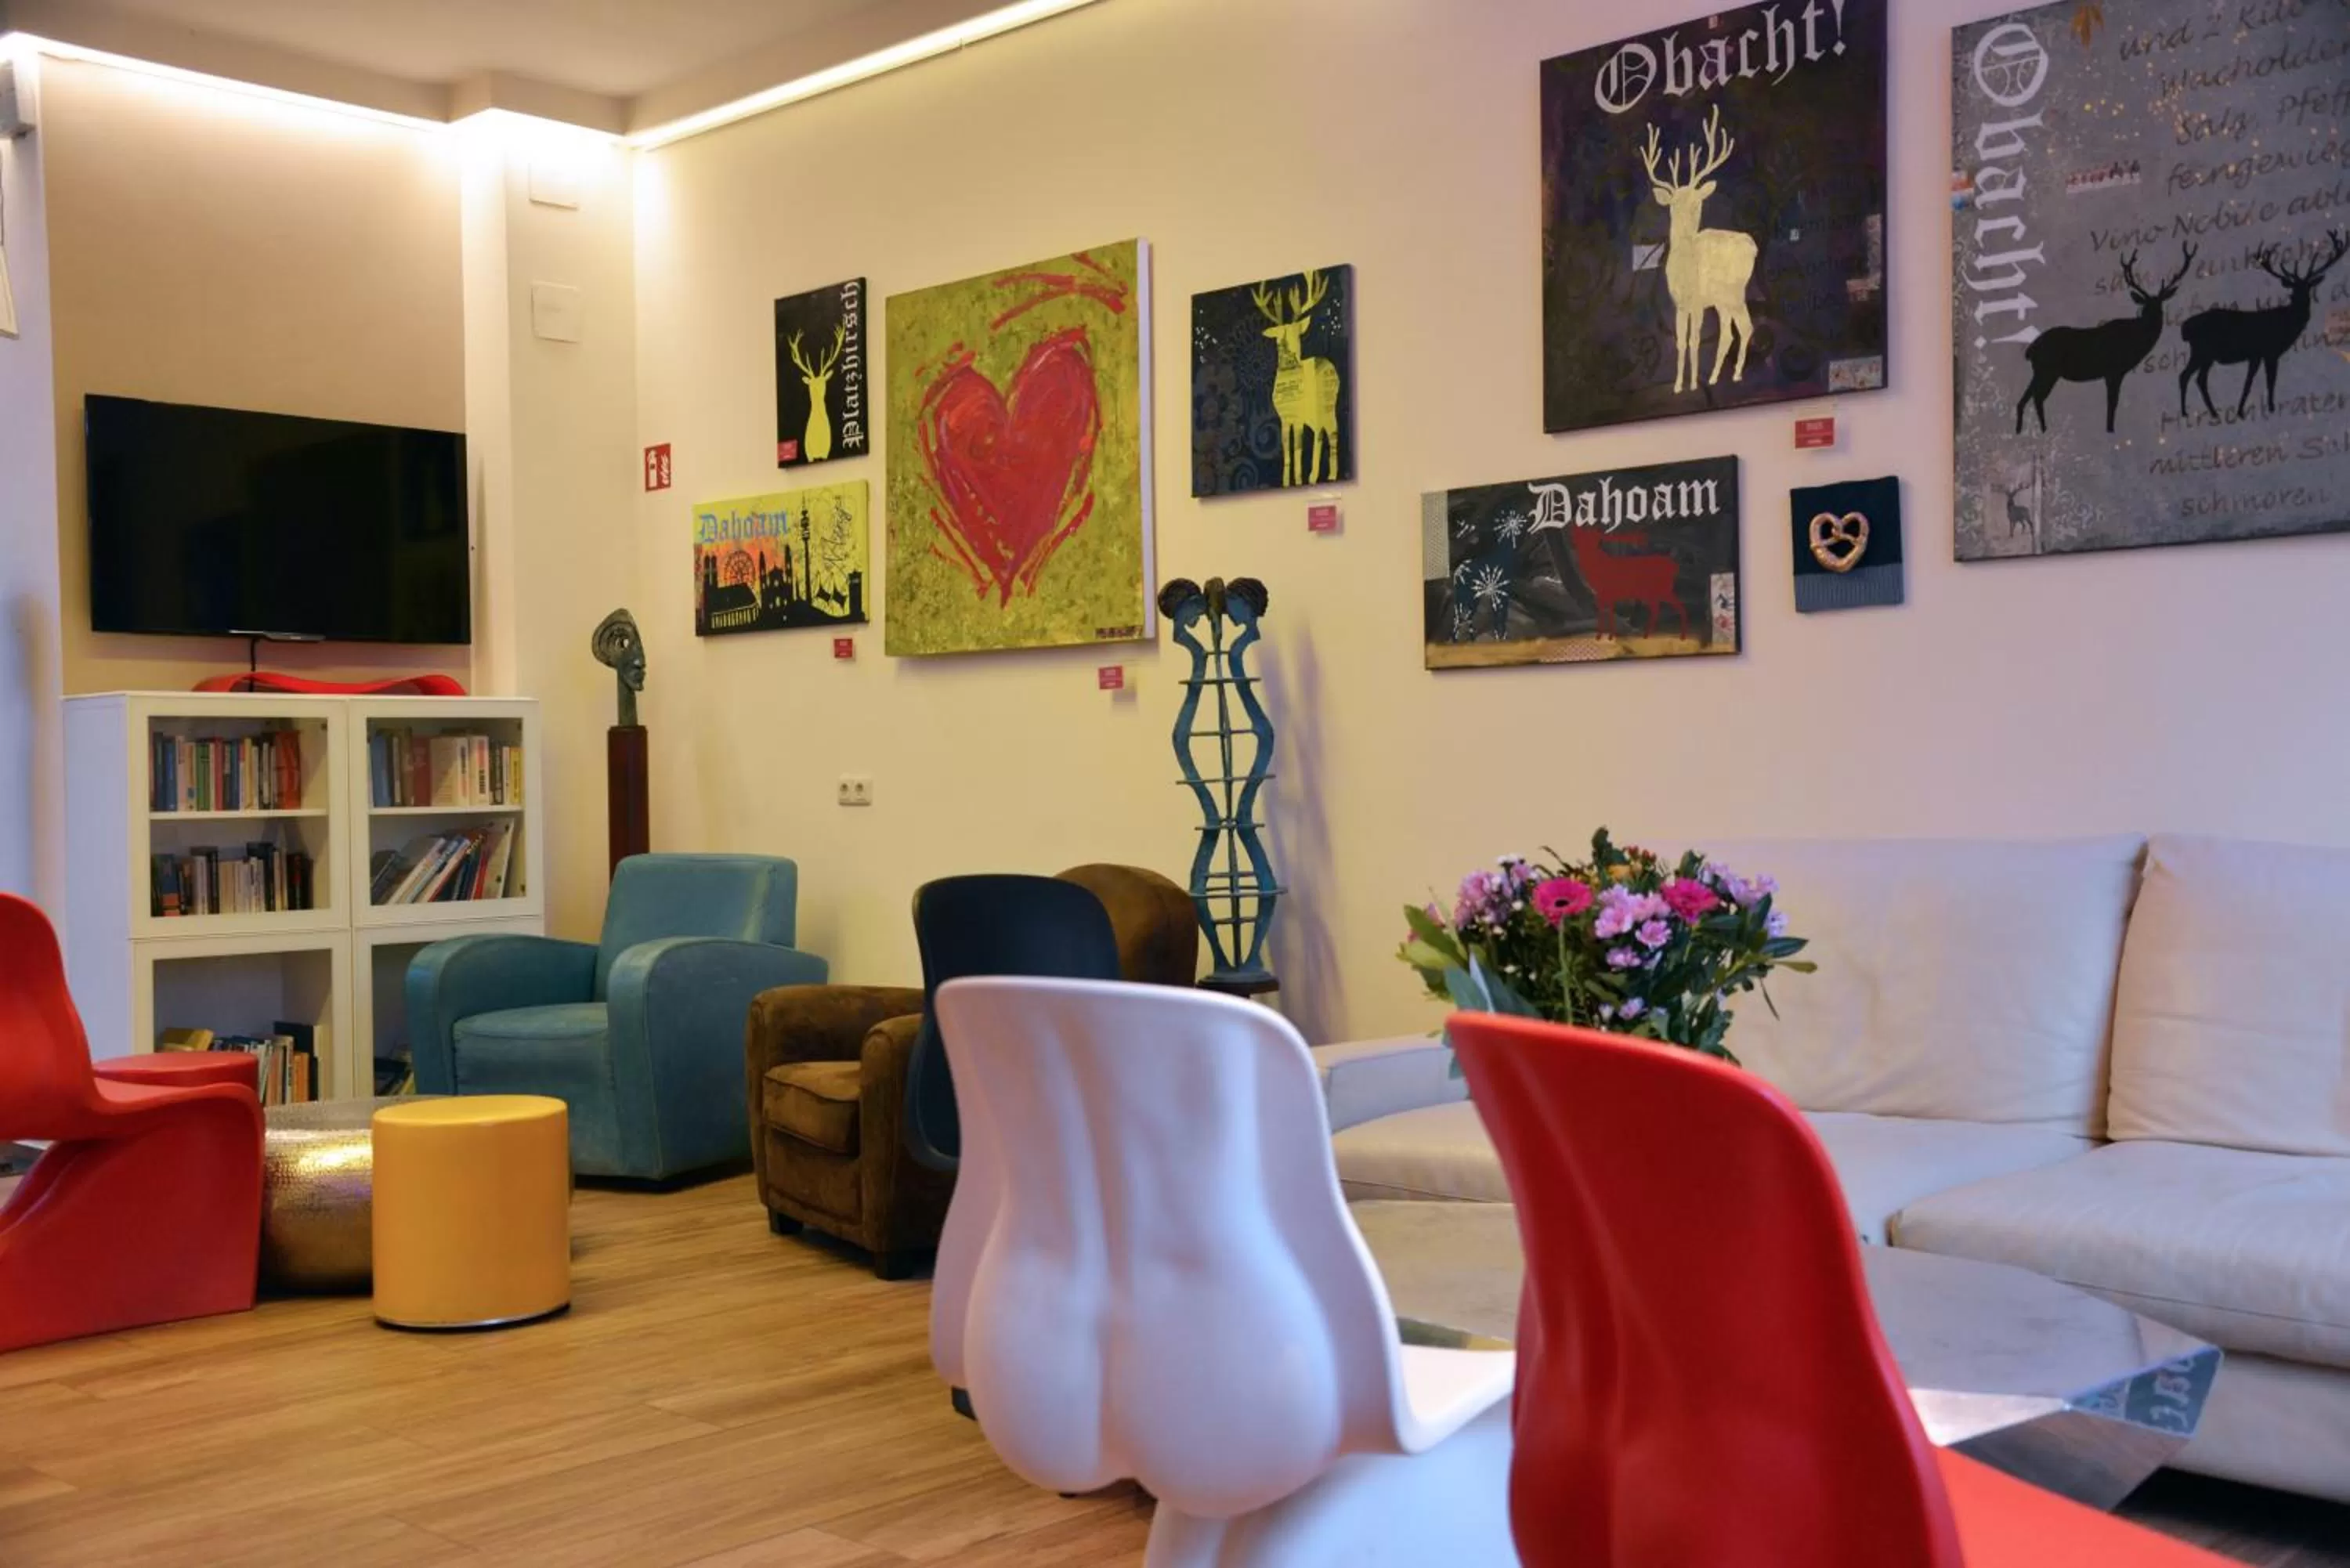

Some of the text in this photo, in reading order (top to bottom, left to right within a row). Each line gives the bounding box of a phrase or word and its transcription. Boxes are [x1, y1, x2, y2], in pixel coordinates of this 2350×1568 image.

[1593, 0, 1847, 114] Obacht!
[1961, 23, 2048, 348] Obacht!
[842, 280, 864, 448] Platzhirsch
[699, 510, 790, 543] Dahoam
[1527, 475, 1722, 535] Dahoam
